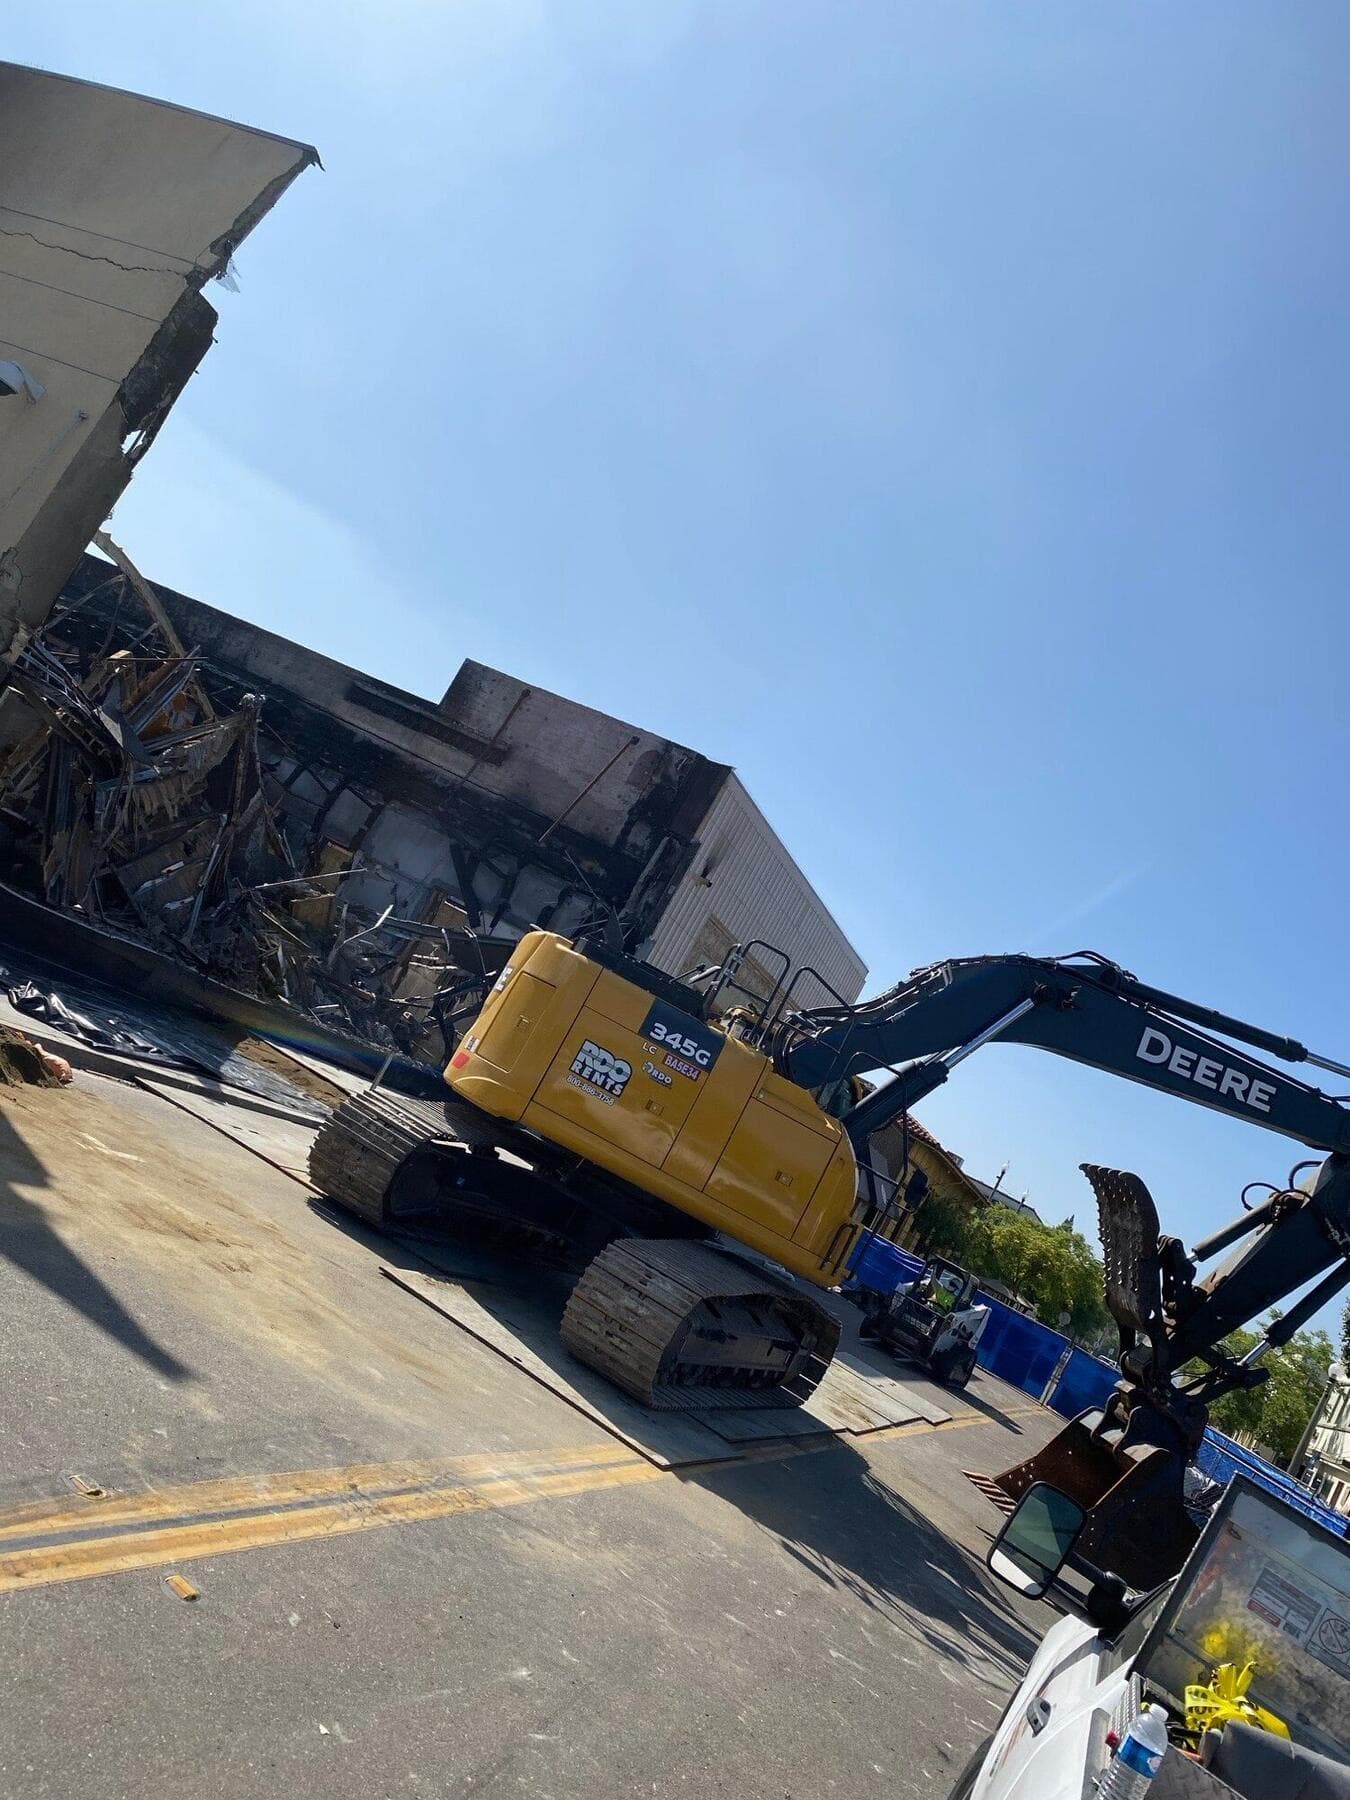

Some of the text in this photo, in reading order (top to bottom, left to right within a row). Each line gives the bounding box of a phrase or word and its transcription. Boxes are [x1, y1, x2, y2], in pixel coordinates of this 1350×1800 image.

[575, 1040, 632, 1083] RDO
[642, 1042, 657, 1055] LC
[650, 1022, 711, 1066] 345G
[570, 1060, 624, 1096] RENTS
[651, 1069, 672, 1084] RDO
[1136, 1026, 1277, 1113] DEERE
